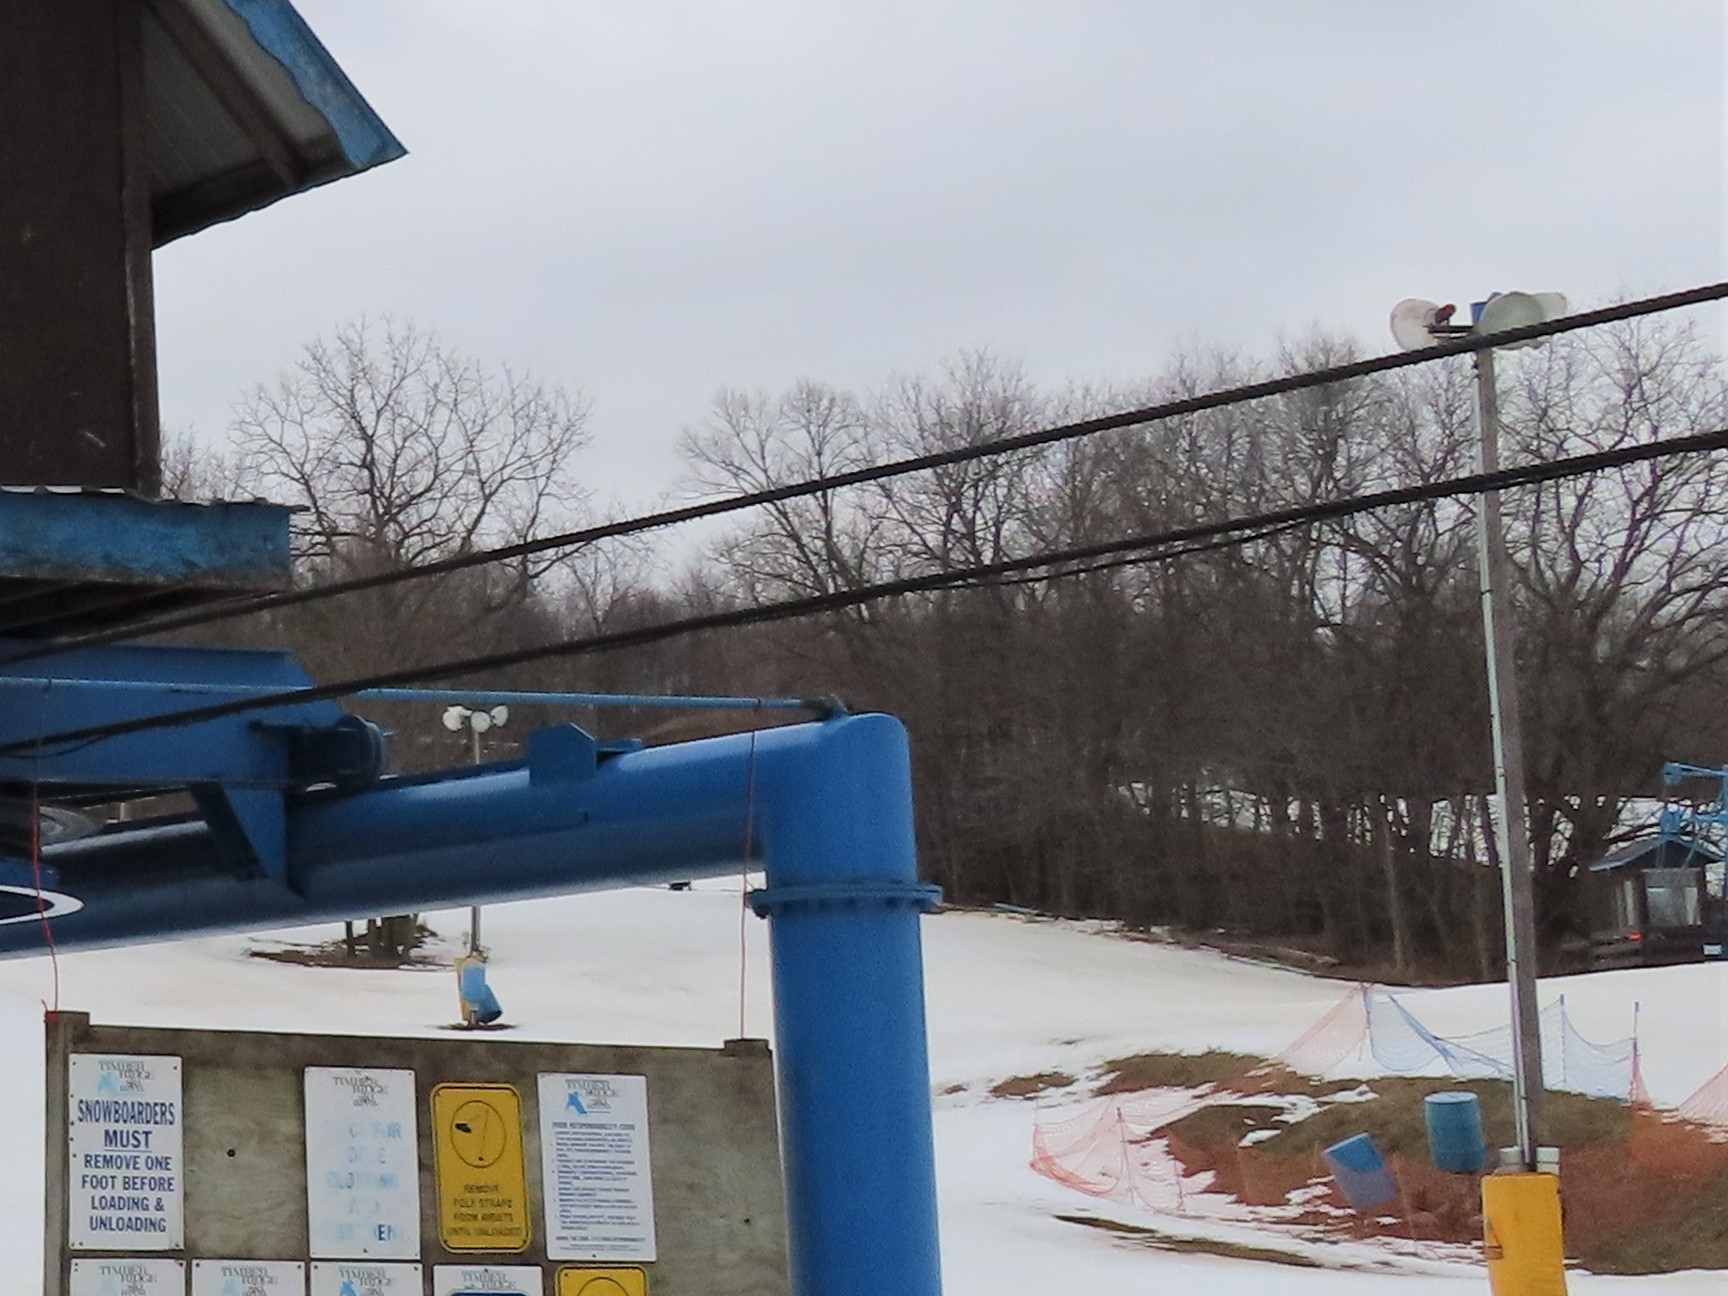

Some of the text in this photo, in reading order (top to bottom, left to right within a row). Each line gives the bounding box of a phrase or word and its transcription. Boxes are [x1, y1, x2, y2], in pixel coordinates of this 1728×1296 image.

[78, 1099, 175, 1125] SNOWBOARDERS
[104, 1130, 153, 1149] MUST
[84, 1154, 172, 1171] REMOVE ONE
[81, 1175, 175, 1191] FOOT BEFORE
[91, 1195, 165, 1212] LOADING &
[90, 1216, 167, 1233] UNLOADING
